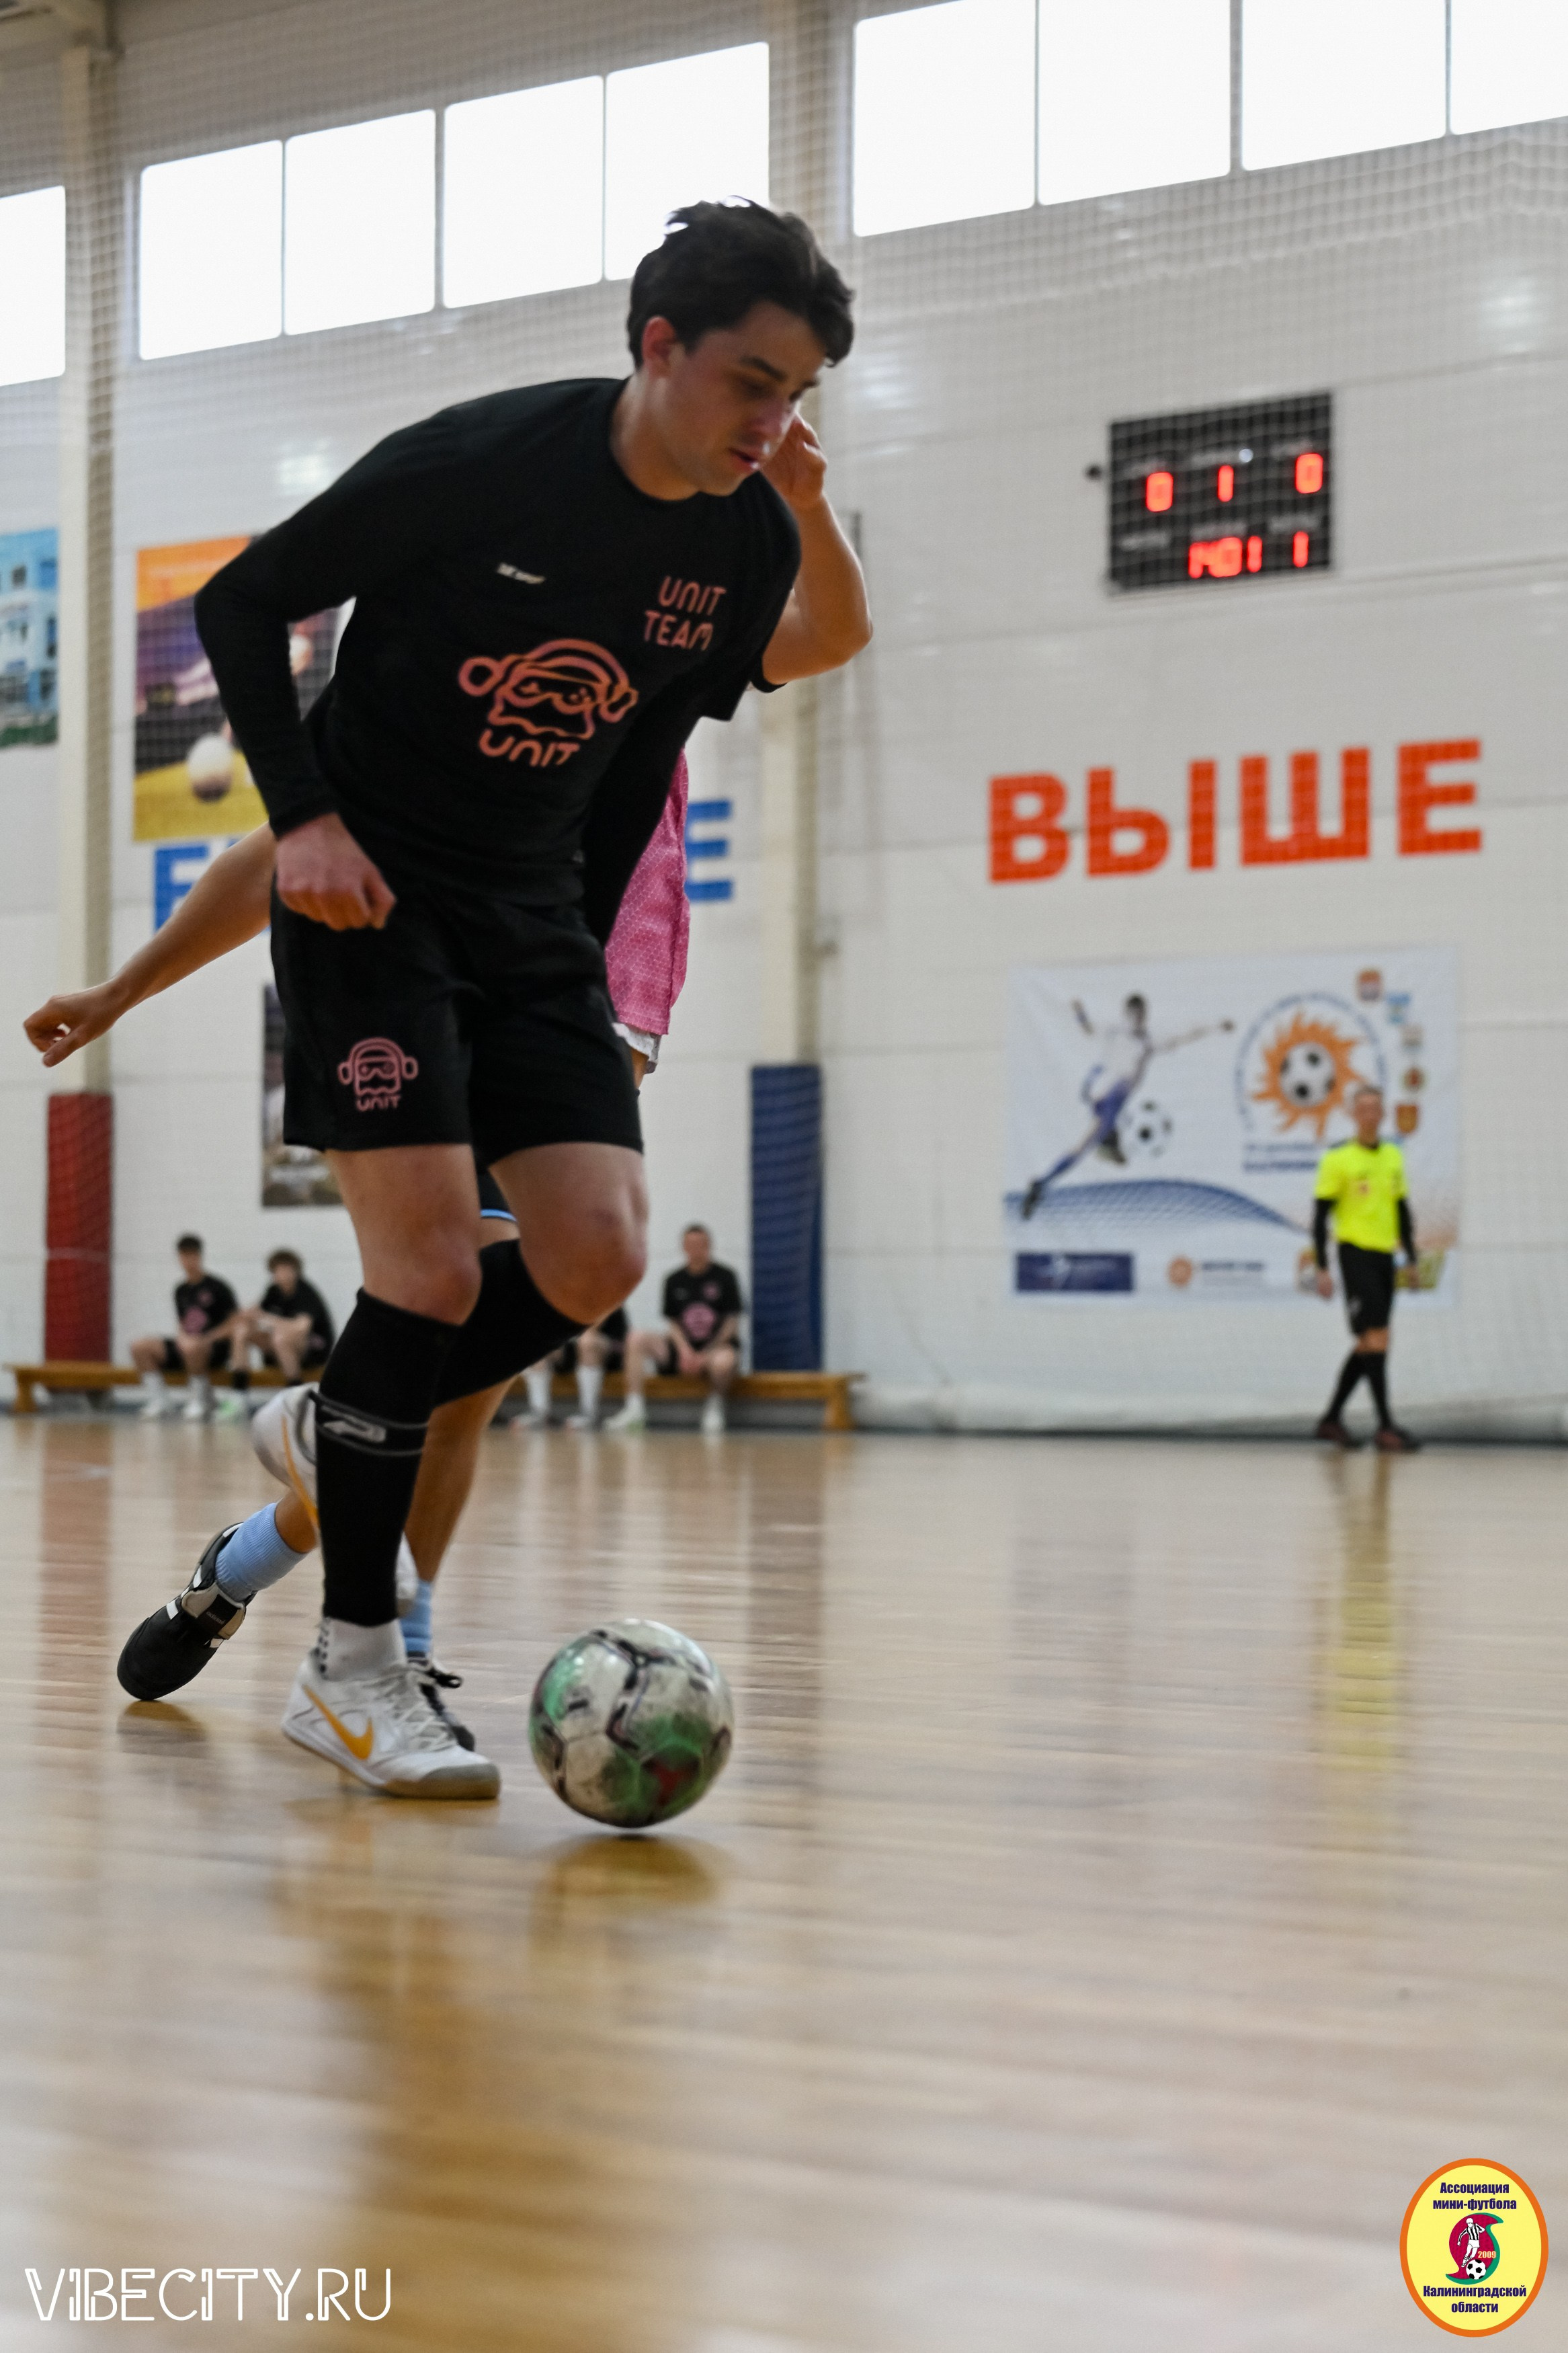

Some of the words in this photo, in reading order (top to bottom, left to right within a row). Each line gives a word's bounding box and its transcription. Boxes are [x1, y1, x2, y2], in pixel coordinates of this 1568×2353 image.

[1218, 465, 1234, 502] 1
[659, 575, 727, 616] UNIT
[644, 610, 714, 651] TEAM
[478, 729, 580, 767] UNIT
[989, 738, 1483, 885] ВЫШЕ
[356, 1094, 402, 1112] UNIT
